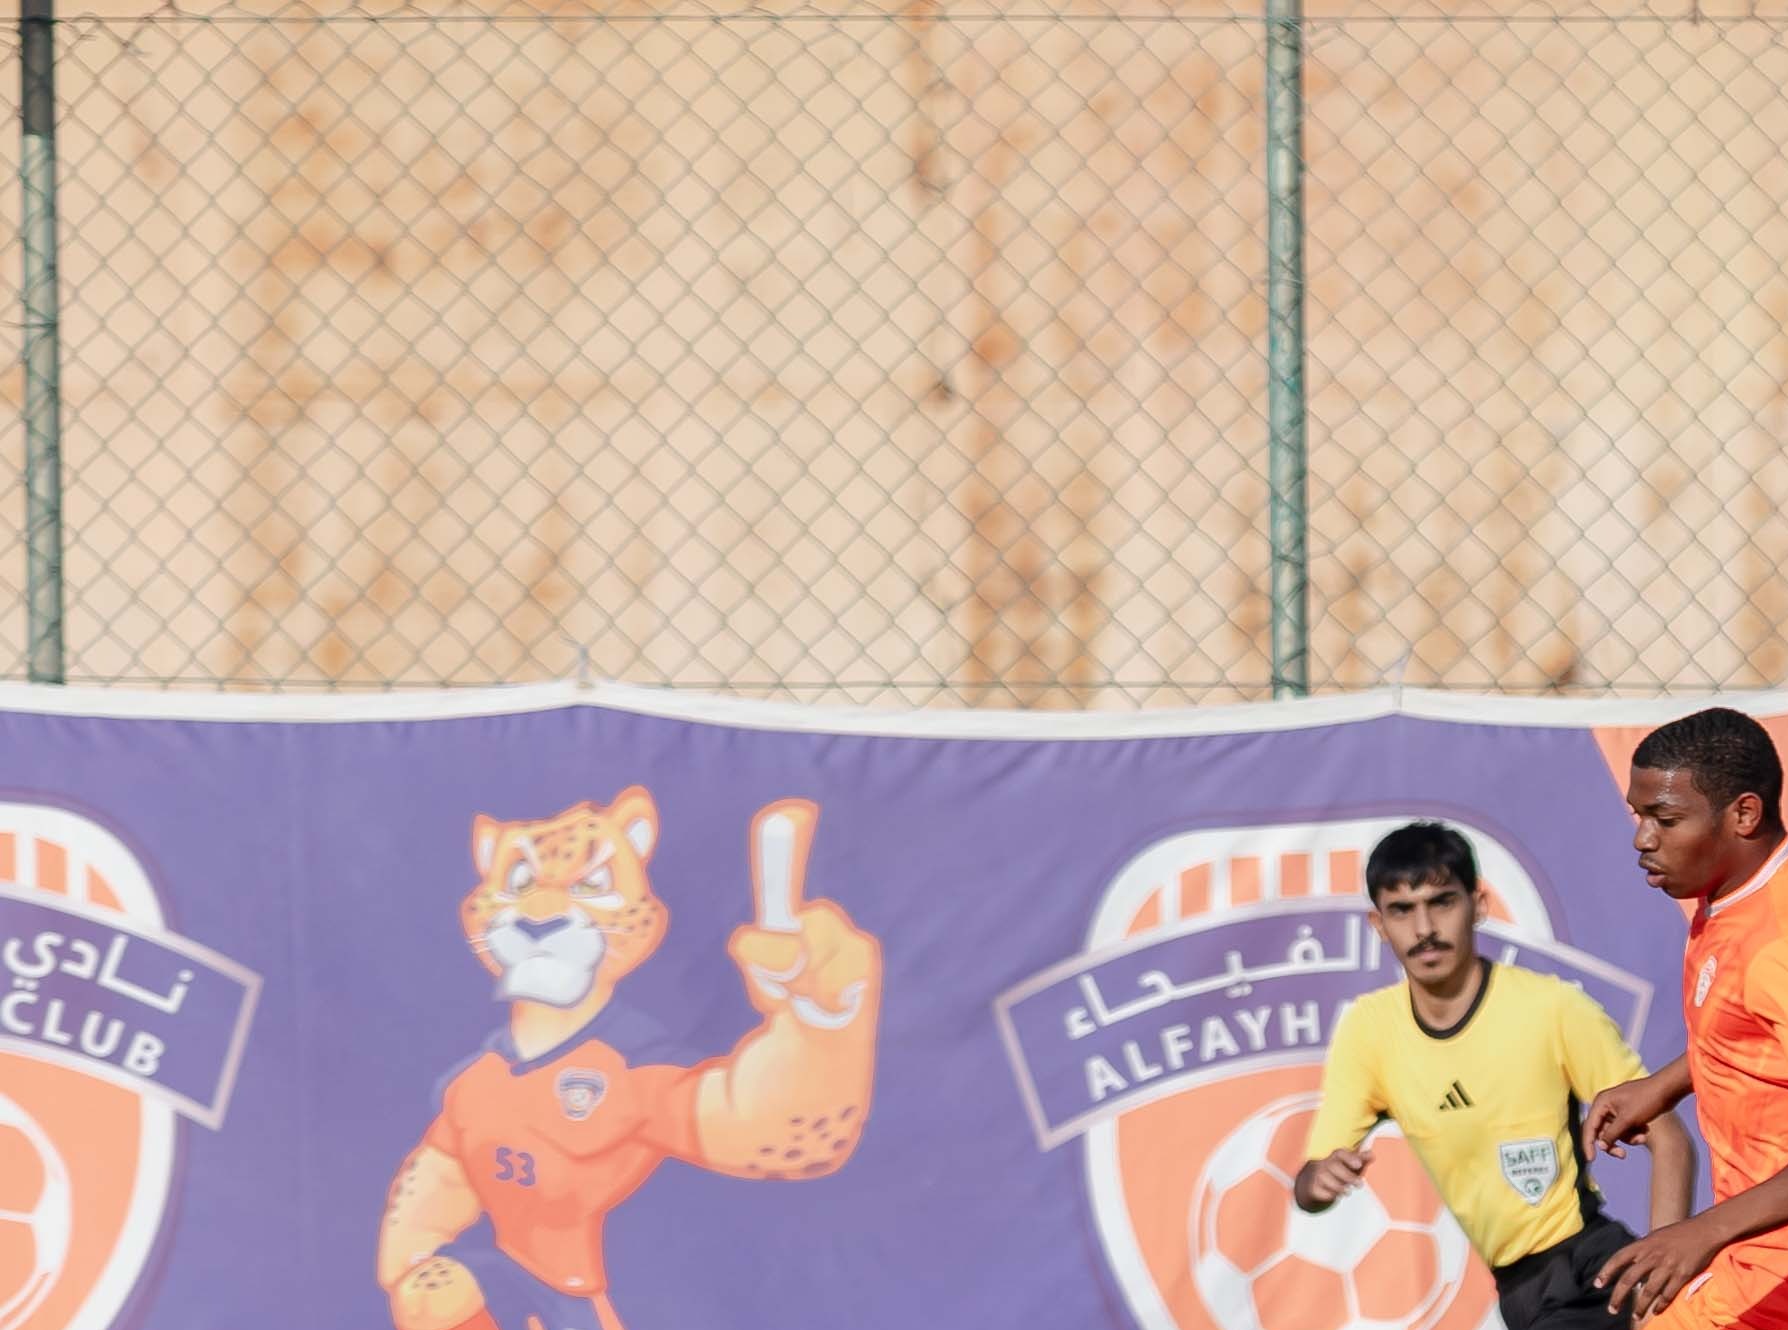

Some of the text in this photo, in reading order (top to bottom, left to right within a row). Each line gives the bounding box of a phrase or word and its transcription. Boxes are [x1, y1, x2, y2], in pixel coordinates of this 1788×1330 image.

[3, 931, 195, 1014] نادي
[1063, 914, 1381, 1040] الفيحاء
[0, 990, 165, 1076] CLUB
[1084, 1000, 1353, 1100] ALFAYH
[495, 1146, 536, 1187] 53
[1503, 1146, 1552, 1167] SAFF
